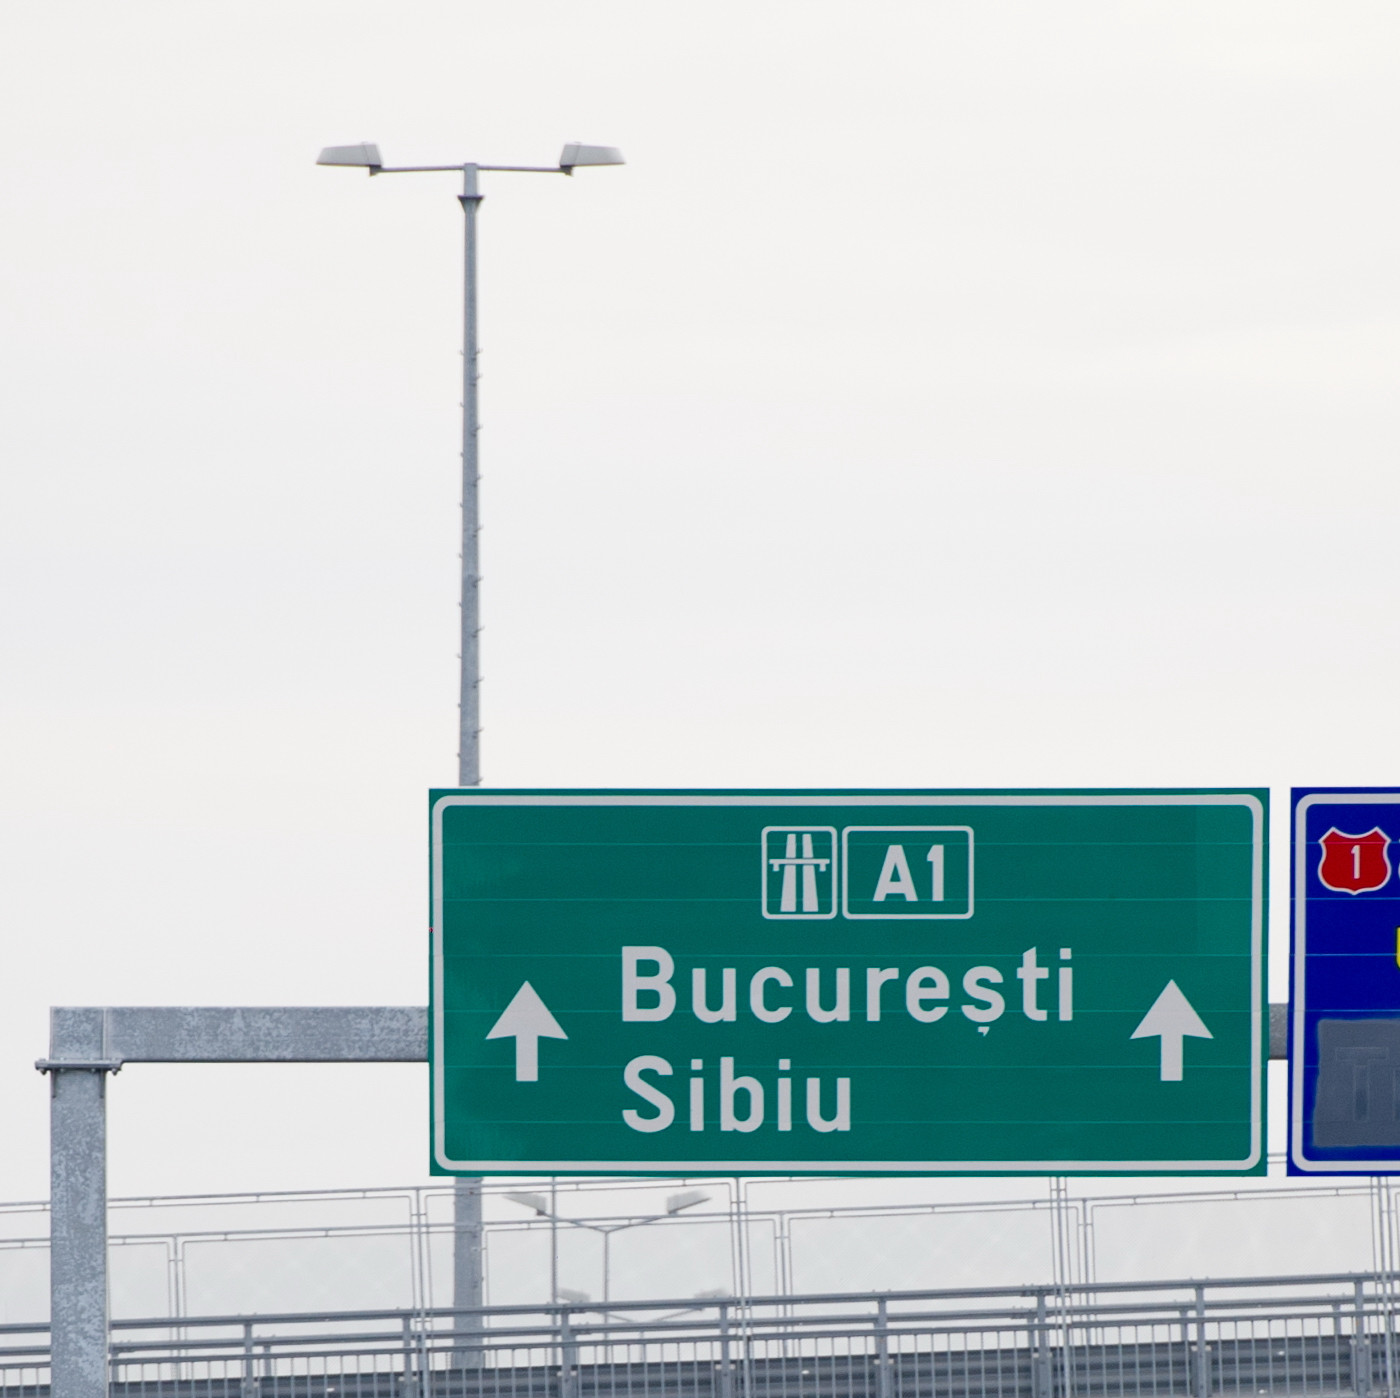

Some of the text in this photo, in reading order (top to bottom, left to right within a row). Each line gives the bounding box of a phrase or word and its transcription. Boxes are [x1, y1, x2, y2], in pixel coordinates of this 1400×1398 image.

[872, 844, 946, 902] A1
[1350, 844, 1361, 879] 1
[621, 945, 1074, 1036] București
[621, 1055, 852, 1133] Sibiu
